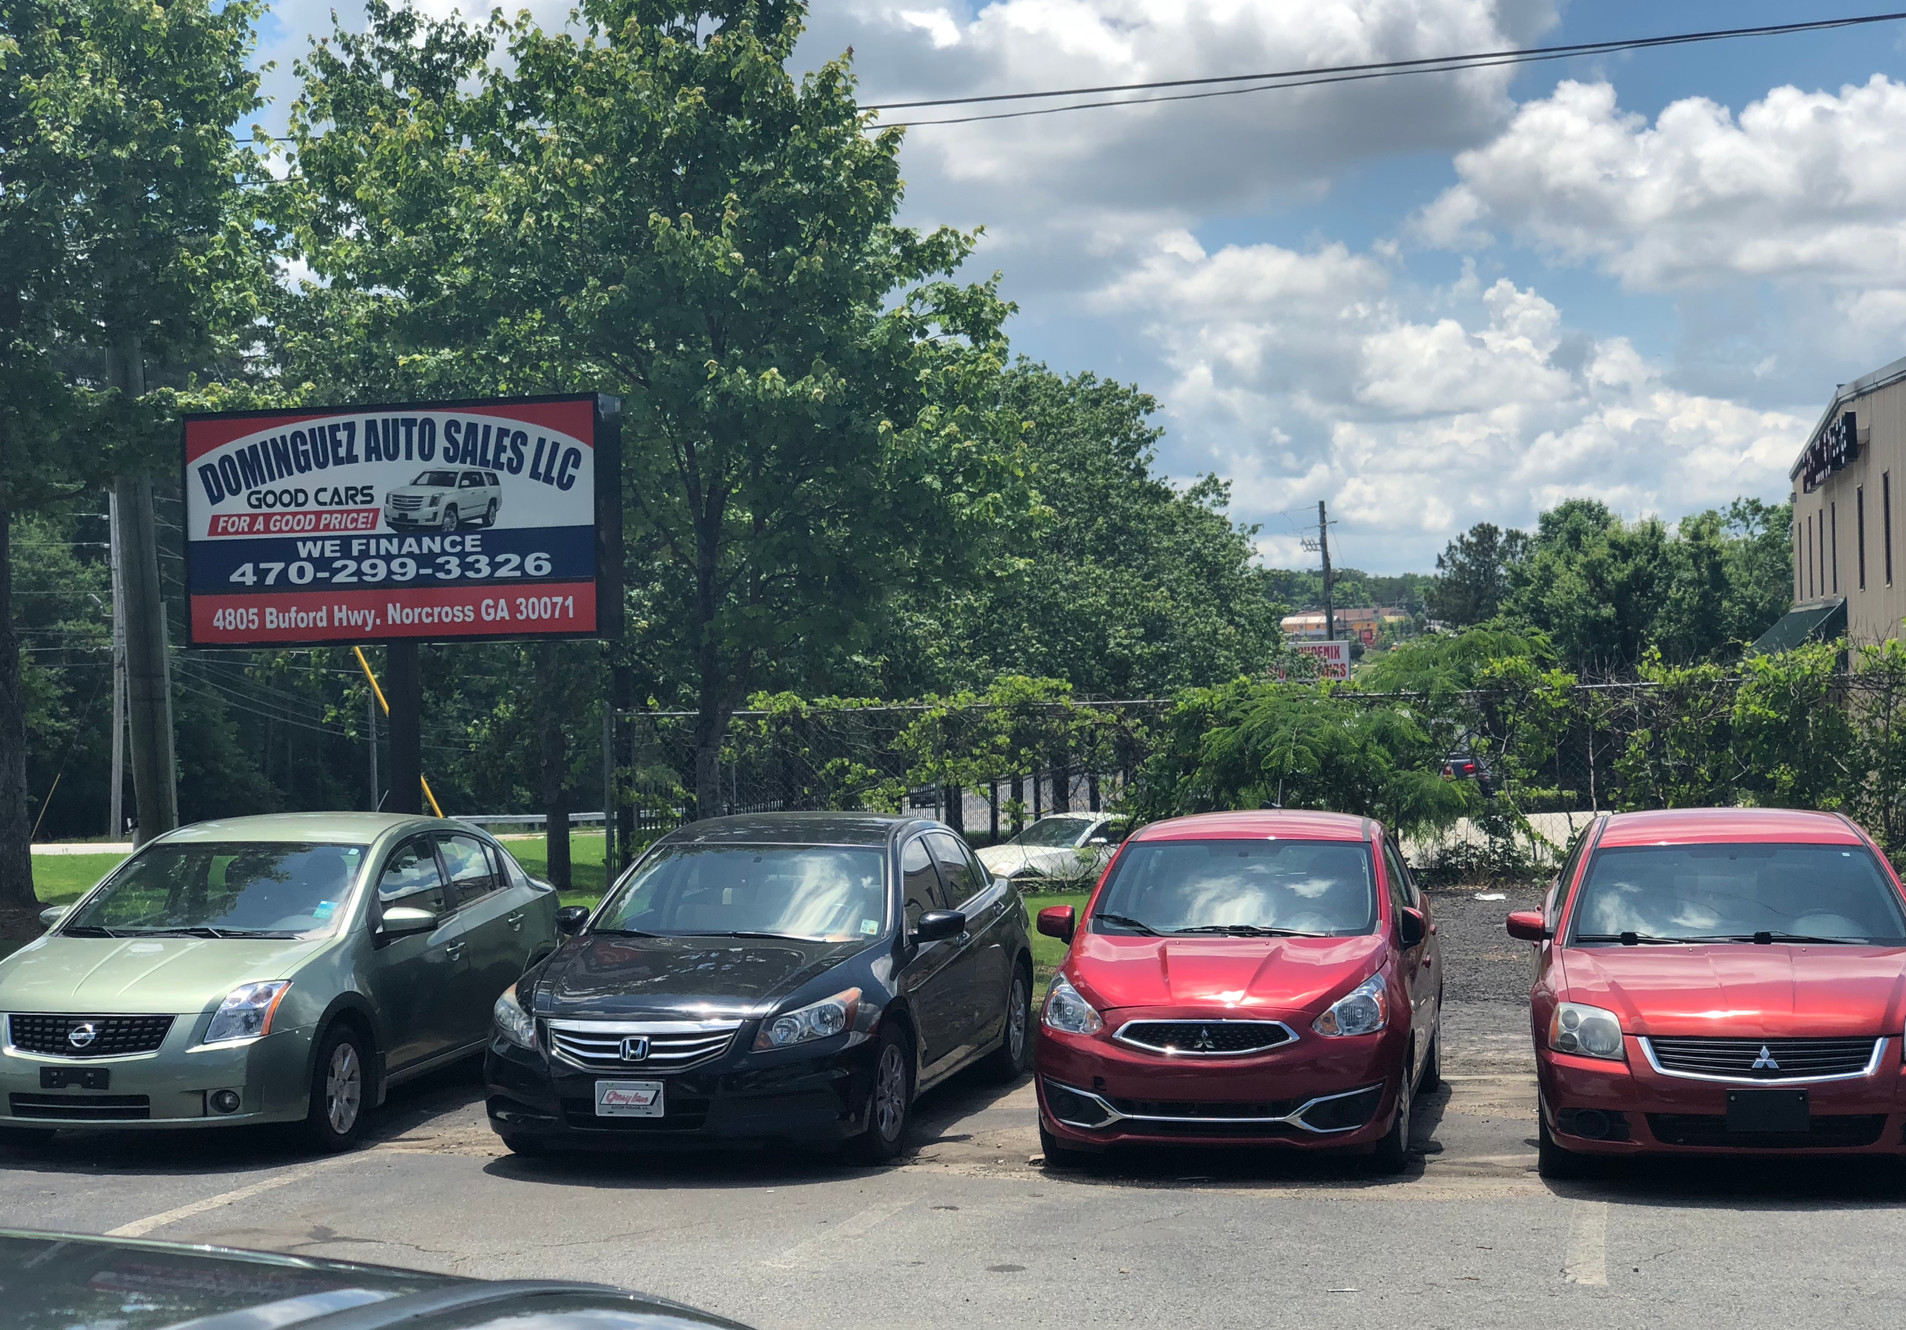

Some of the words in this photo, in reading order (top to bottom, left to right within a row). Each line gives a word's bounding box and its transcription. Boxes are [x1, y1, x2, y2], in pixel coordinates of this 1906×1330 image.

[197, 421, 359, 506] DOMINGUEZ
[364, 417, 436, 462] AUTO
[442, 419, 528, 475] SALES
[528, 436, 582, 491] LLC
[246, 489, 309, 509] GOOD
[313, 485, 375, 506] CARS
[217, 516, 250, 533] FOR
[253, 515, 264, 532] A
[269, 514, 316, 531] GOOD
[319, 512, 373, 530] PRICE!
[296, 540, 341, 558] WE
[352, 534, 482, 557] FINANCE
[229, 552, 552, 586] 470-299-3326
[213, 608, 259, 631] 4805
[265, 606, 327, 629] Buford
[333, 604, 381, 632] Hwy.
[387, 603, 475, 625] Norcross
[480, 598, 510, 622] GA
[515, 595, 574, 621] 30071
